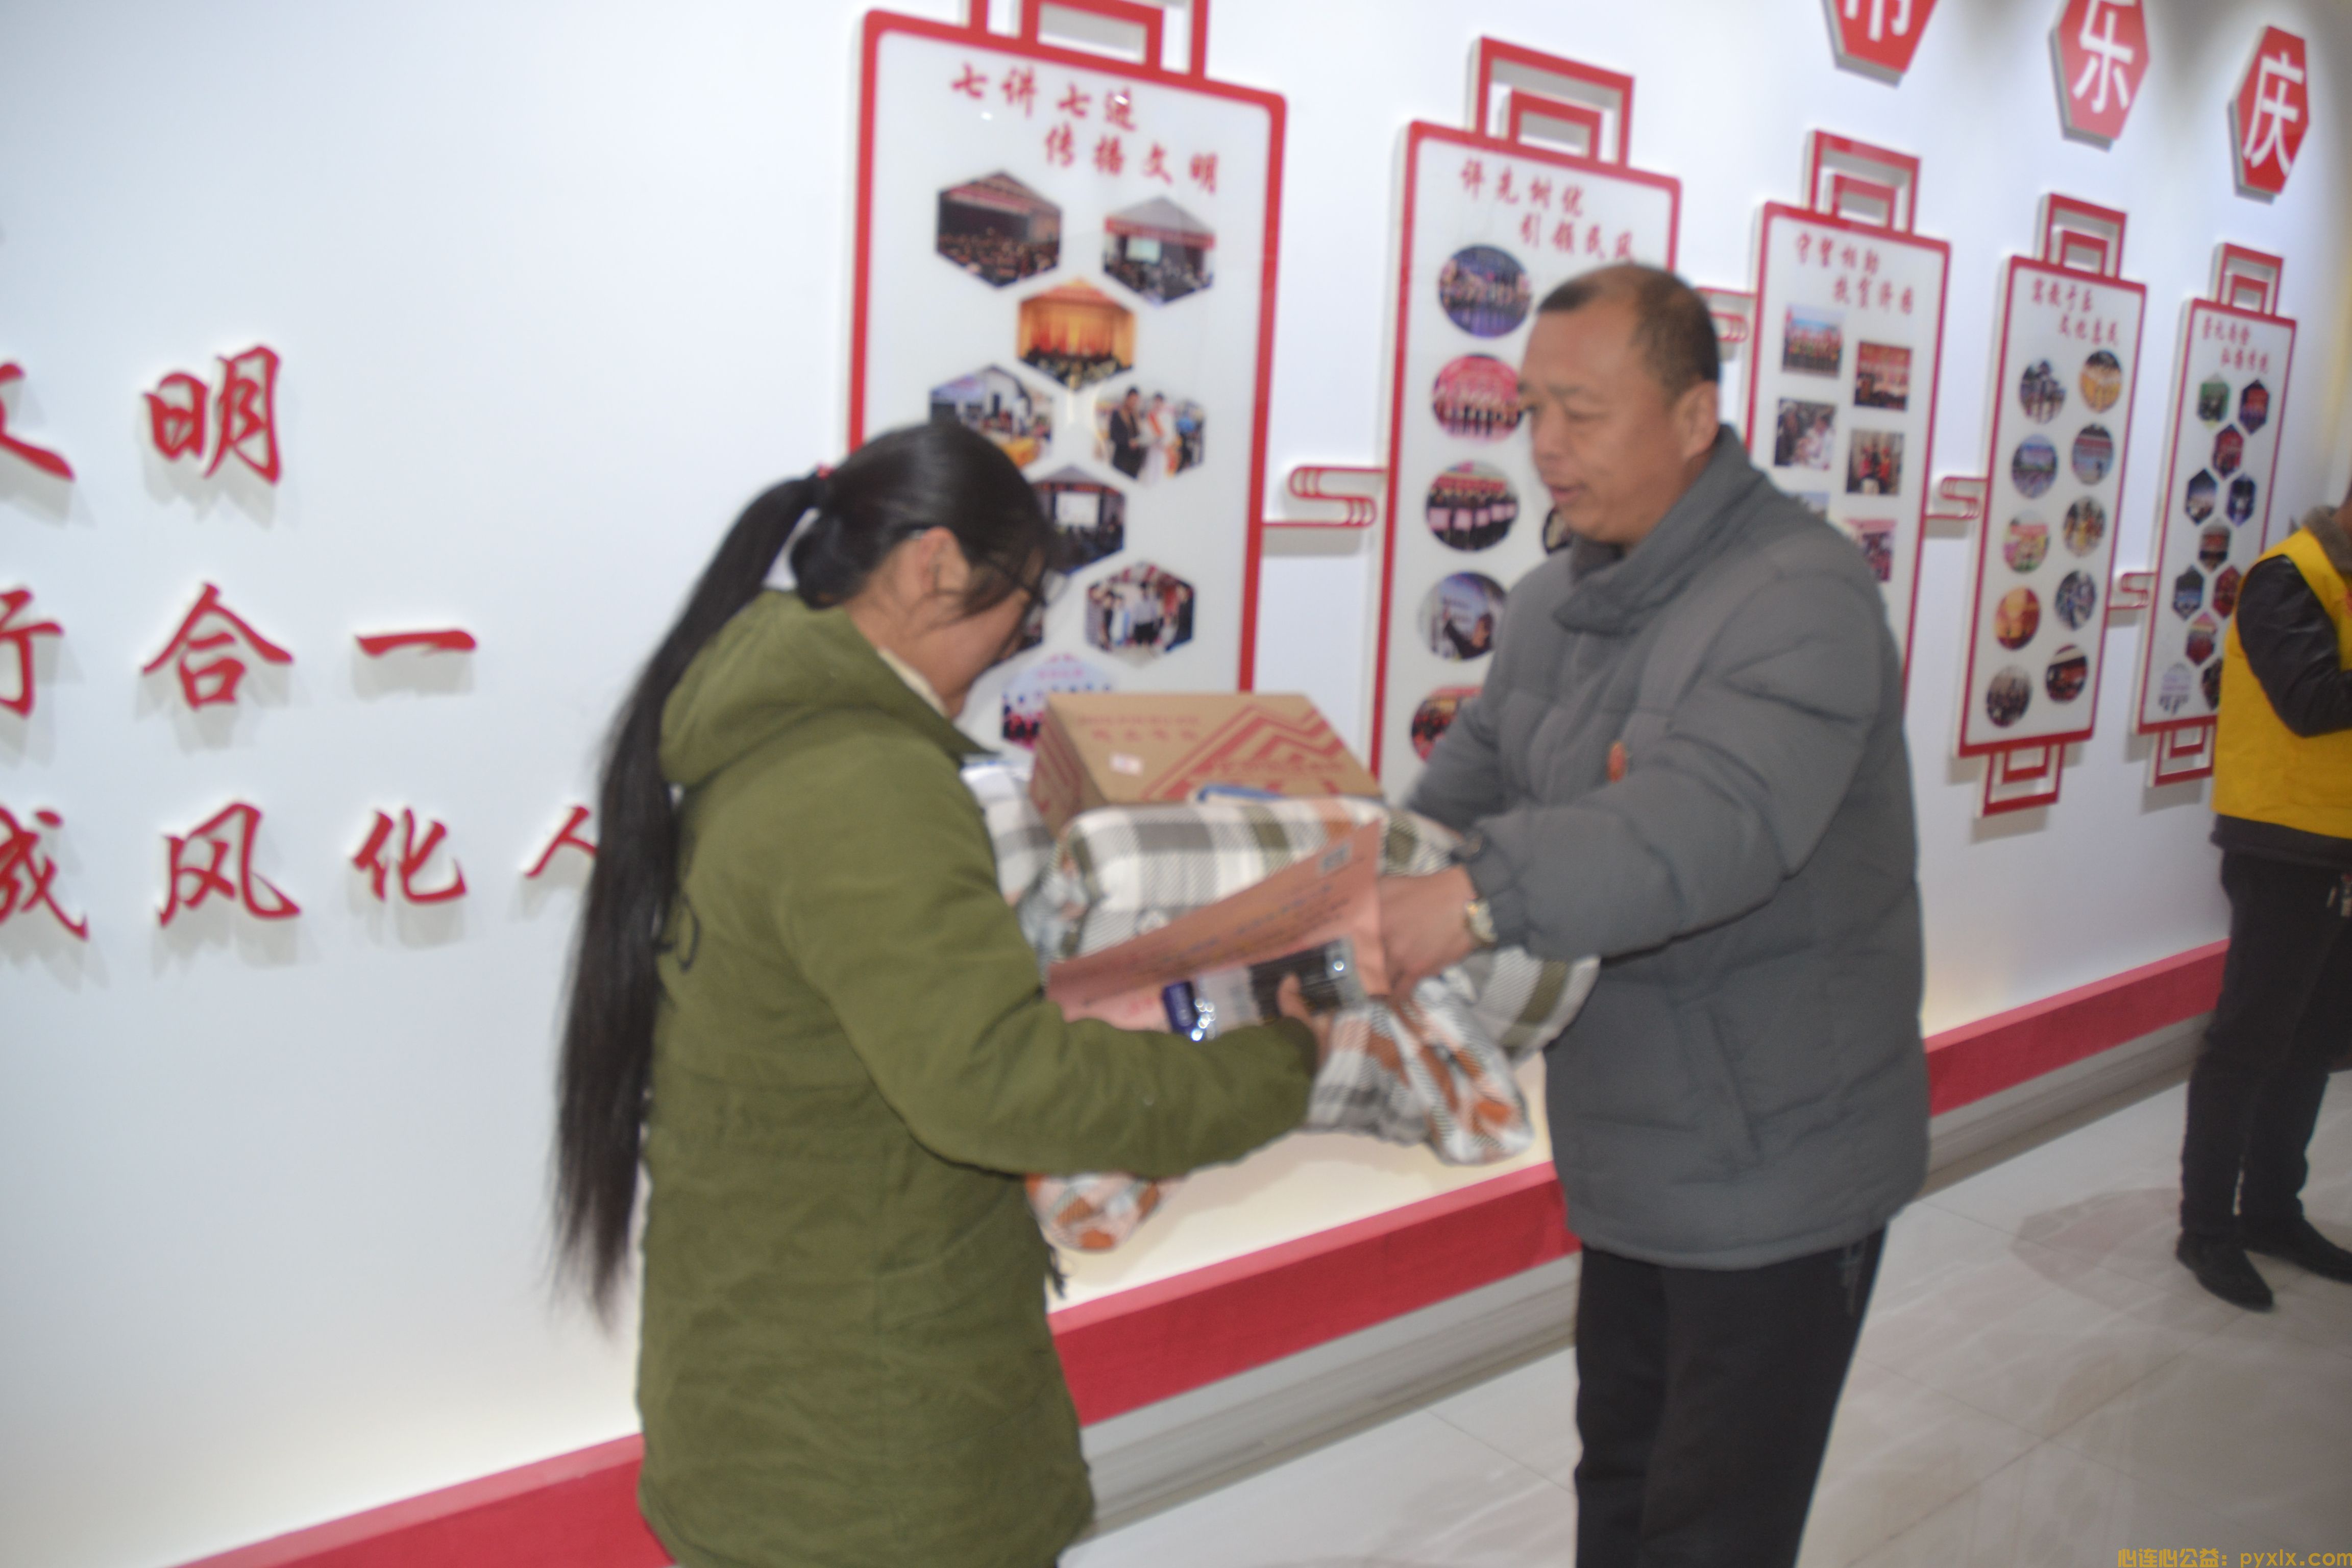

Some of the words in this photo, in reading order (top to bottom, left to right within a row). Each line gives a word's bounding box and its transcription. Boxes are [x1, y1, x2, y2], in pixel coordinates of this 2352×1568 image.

[2073, 0, 2135, 113] 乐
[2244, 52, 2305, 176] 庆
[1045, 122, 1218, 193] 传播文明
